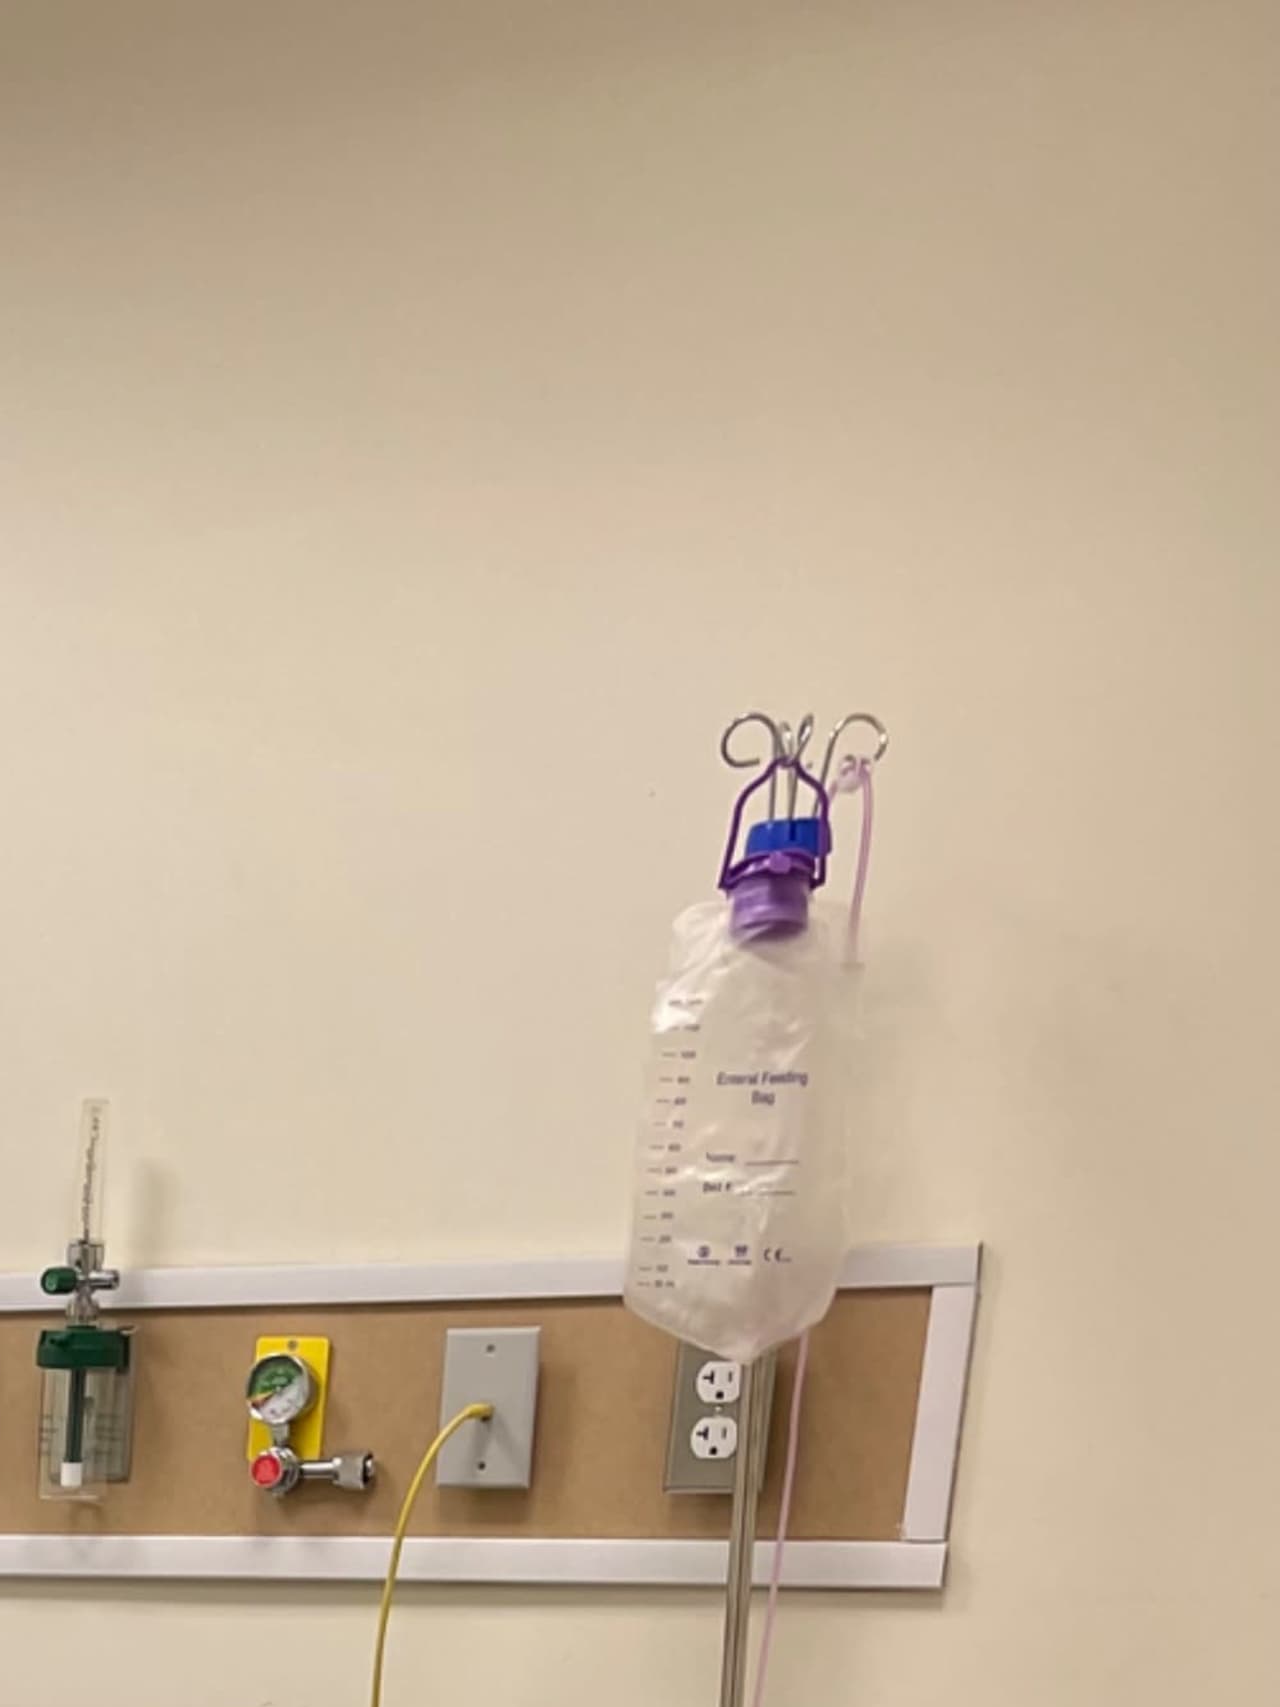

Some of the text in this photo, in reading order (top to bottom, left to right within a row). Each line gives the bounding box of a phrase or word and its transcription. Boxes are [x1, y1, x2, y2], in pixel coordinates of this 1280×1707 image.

[716, 1070, 808, 1087] Enteral Feeding
[751, 1090, 775, 1105] Bag
